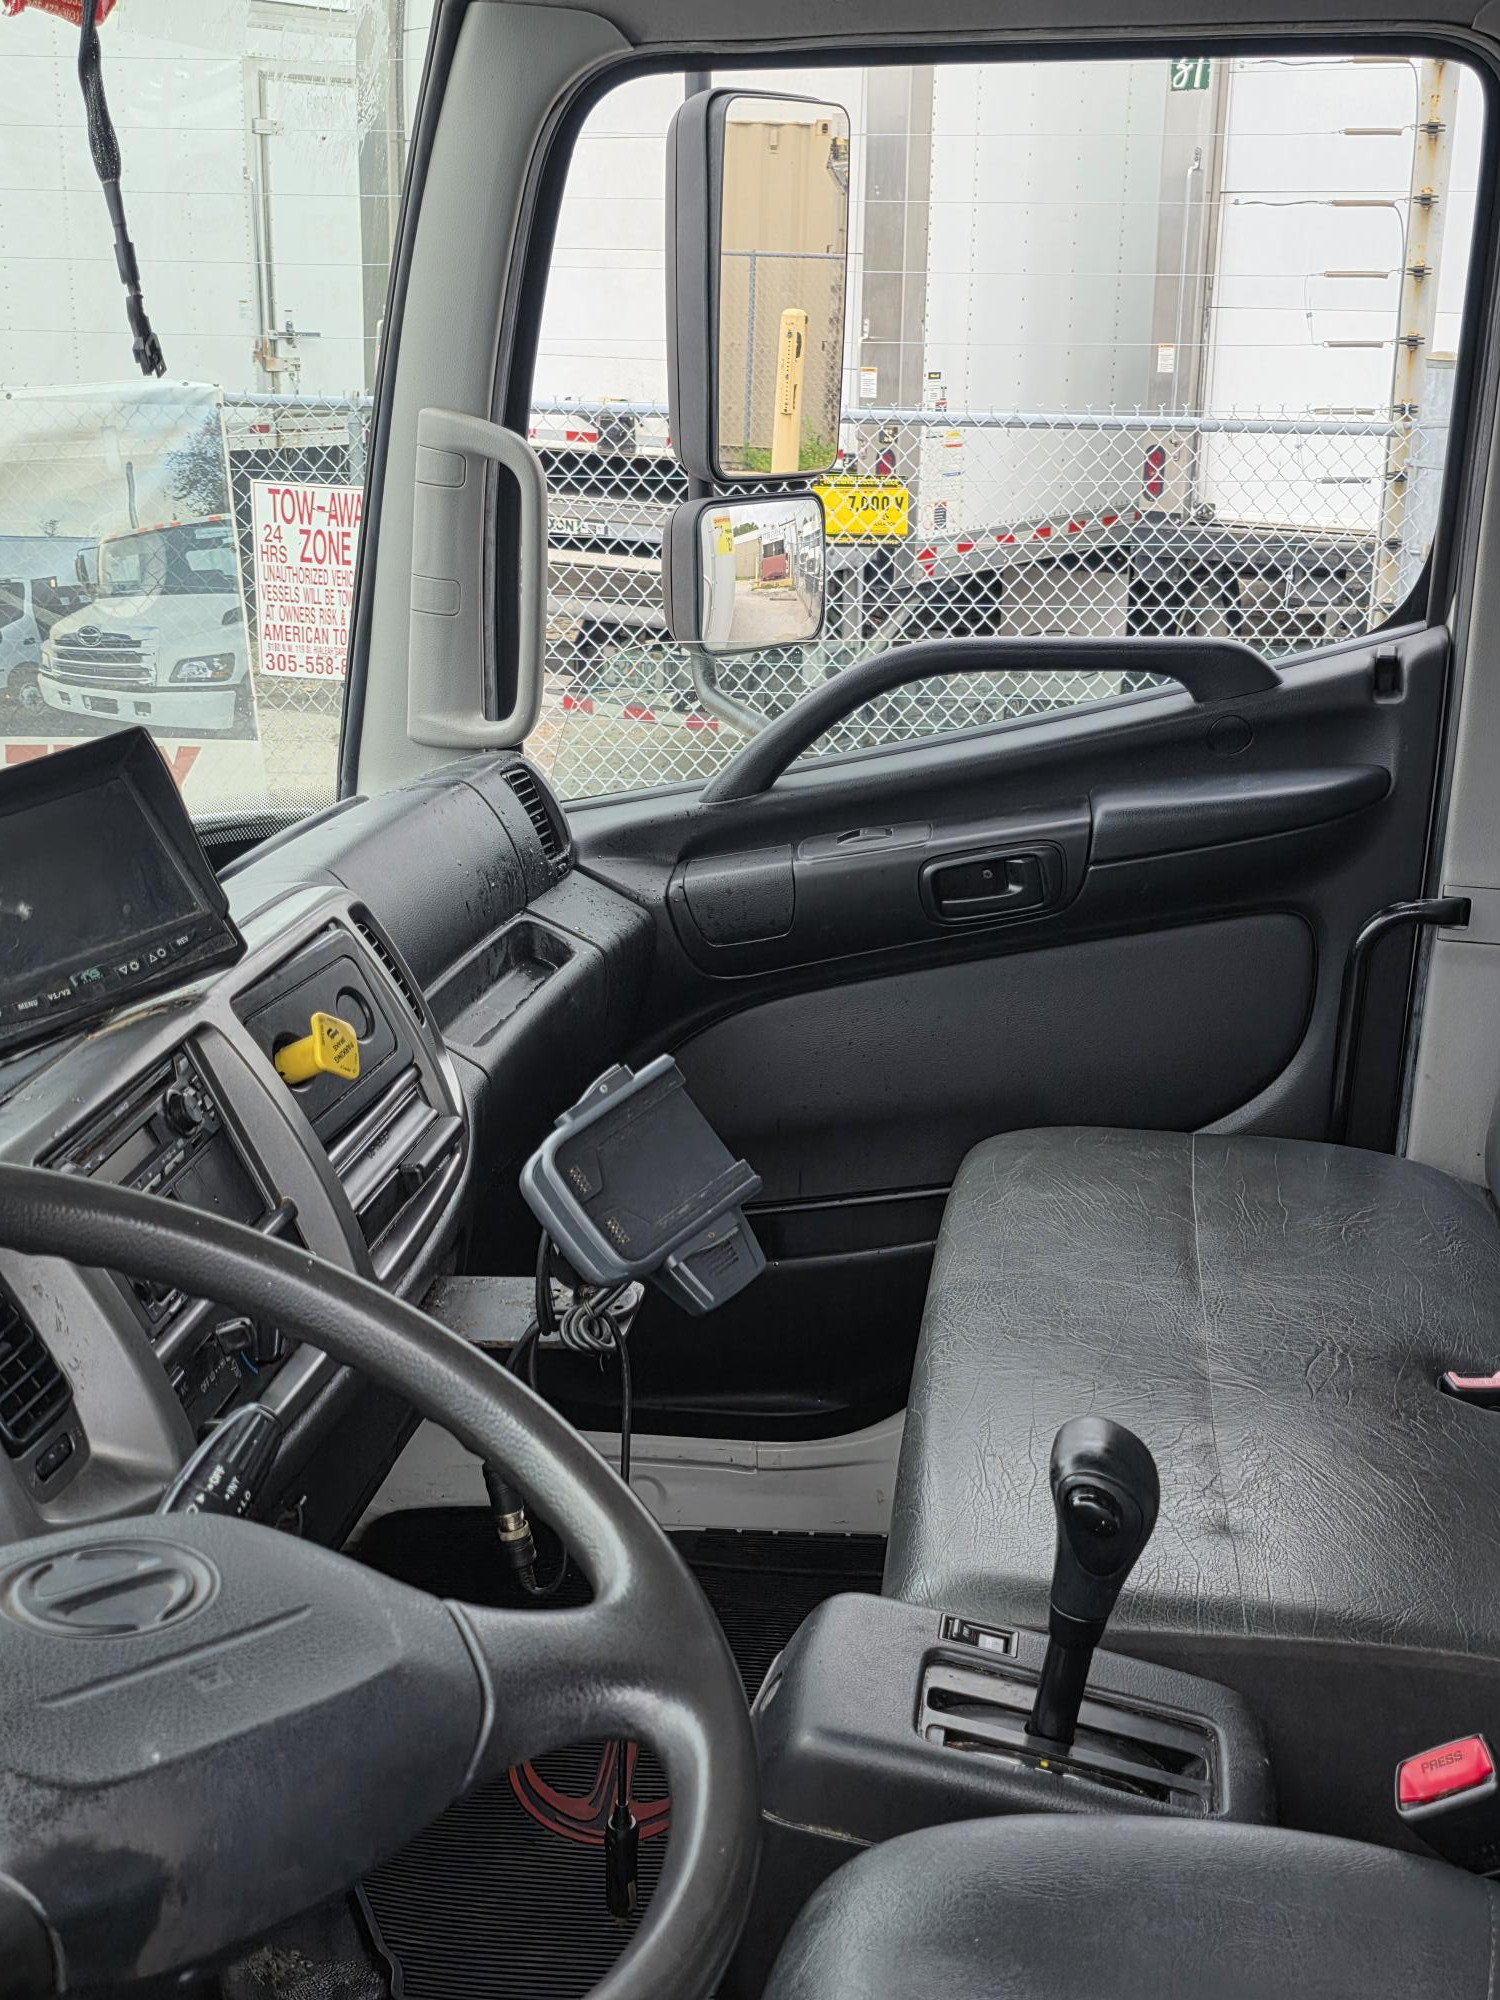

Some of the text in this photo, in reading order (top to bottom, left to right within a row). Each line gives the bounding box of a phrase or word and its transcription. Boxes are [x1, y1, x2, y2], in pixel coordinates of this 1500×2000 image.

[263, 524, 283, 543] 24
[260, 544, 288, 564] HRS
[299, 528, 352, 566] ZONE
[264, 566, 329, 586] UNAUTHORIZED
[261, 584, 300, 603] VESSELS
[303, 587, 322, 605] WILL
[325, 589, 335, 606] BE
[266, 604, 346, 626] AT OWNERS RISK &
[264, 623, 329, 644] AMERICAN
[265, 652, 347, 676] 305-558-8
[176, 935, 189, 947] REV
[17, 999, 38, 1011] MENU
[209, 1464, 225, 1486] OFF
[1421, 1750, 1463, 1774] PRESS
